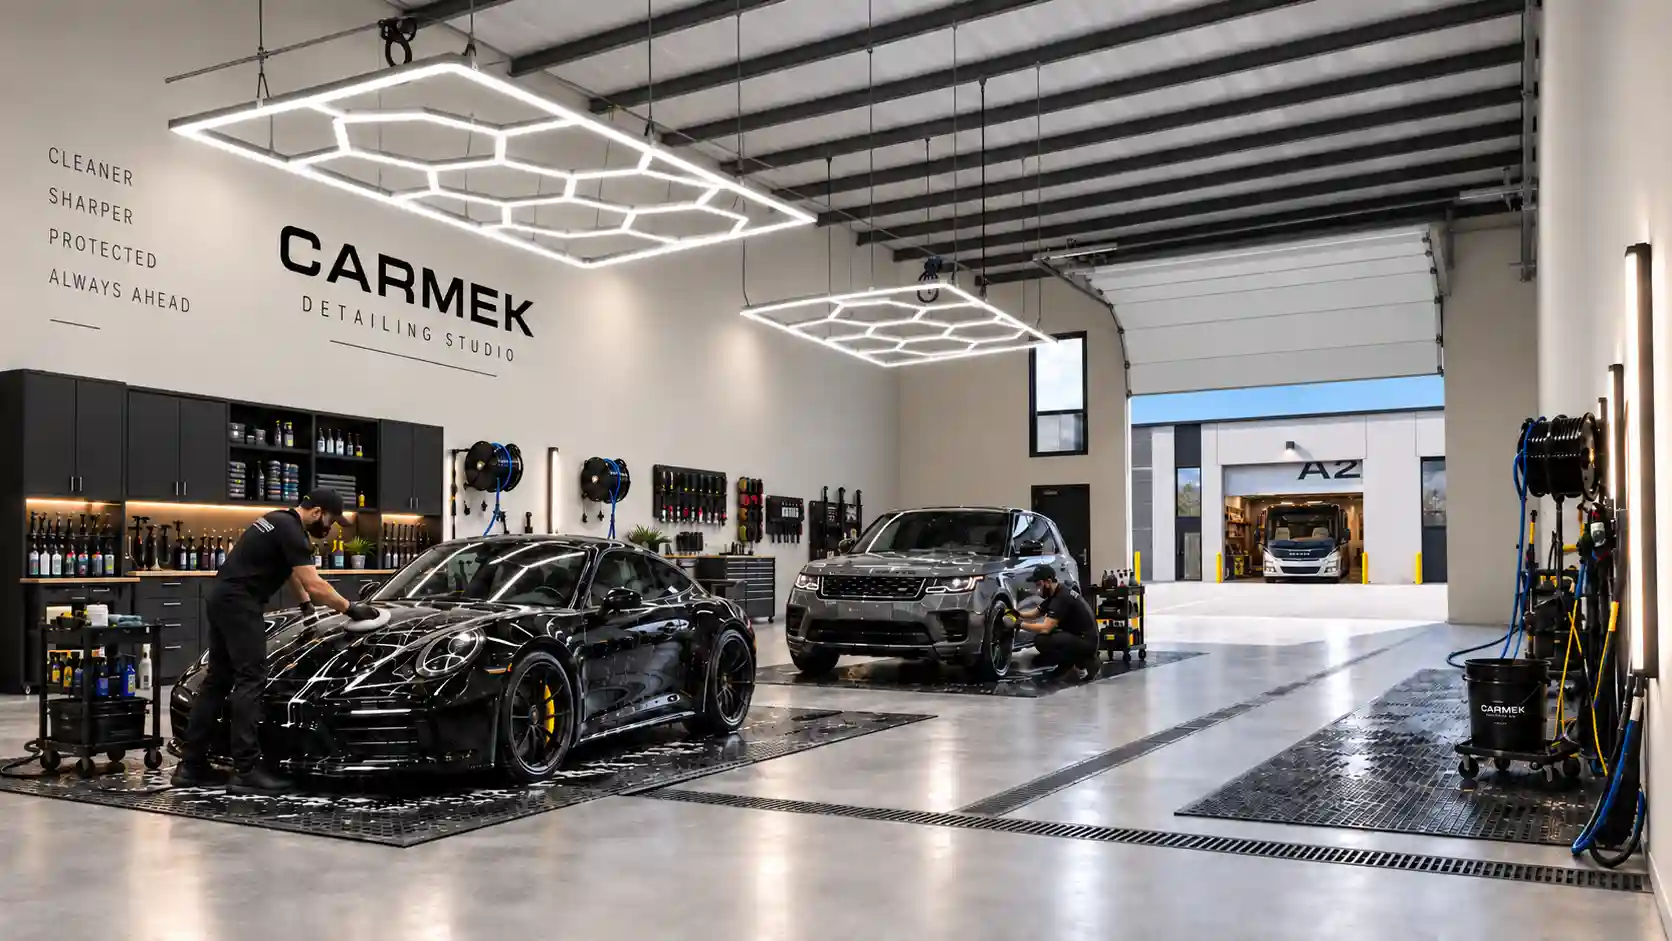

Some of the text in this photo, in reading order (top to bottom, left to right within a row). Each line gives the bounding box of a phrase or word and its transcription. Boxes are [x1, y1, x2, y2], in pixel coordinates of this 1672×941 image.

[48, 146, 134, 186] CLEANER
[48, 187, 133, 225] SHARPER
[49, 228, 157, 269] PROTECTED
[48, 268, 191, 313] ALWAYS AHEAD
[280, 225, 535, 338] CARMEK
[301, 295, 515, 362] DETAILING STUDIO
[1297, 460, 1361, 480] A2
[1480, 704, 1525, 714] CARMEK
